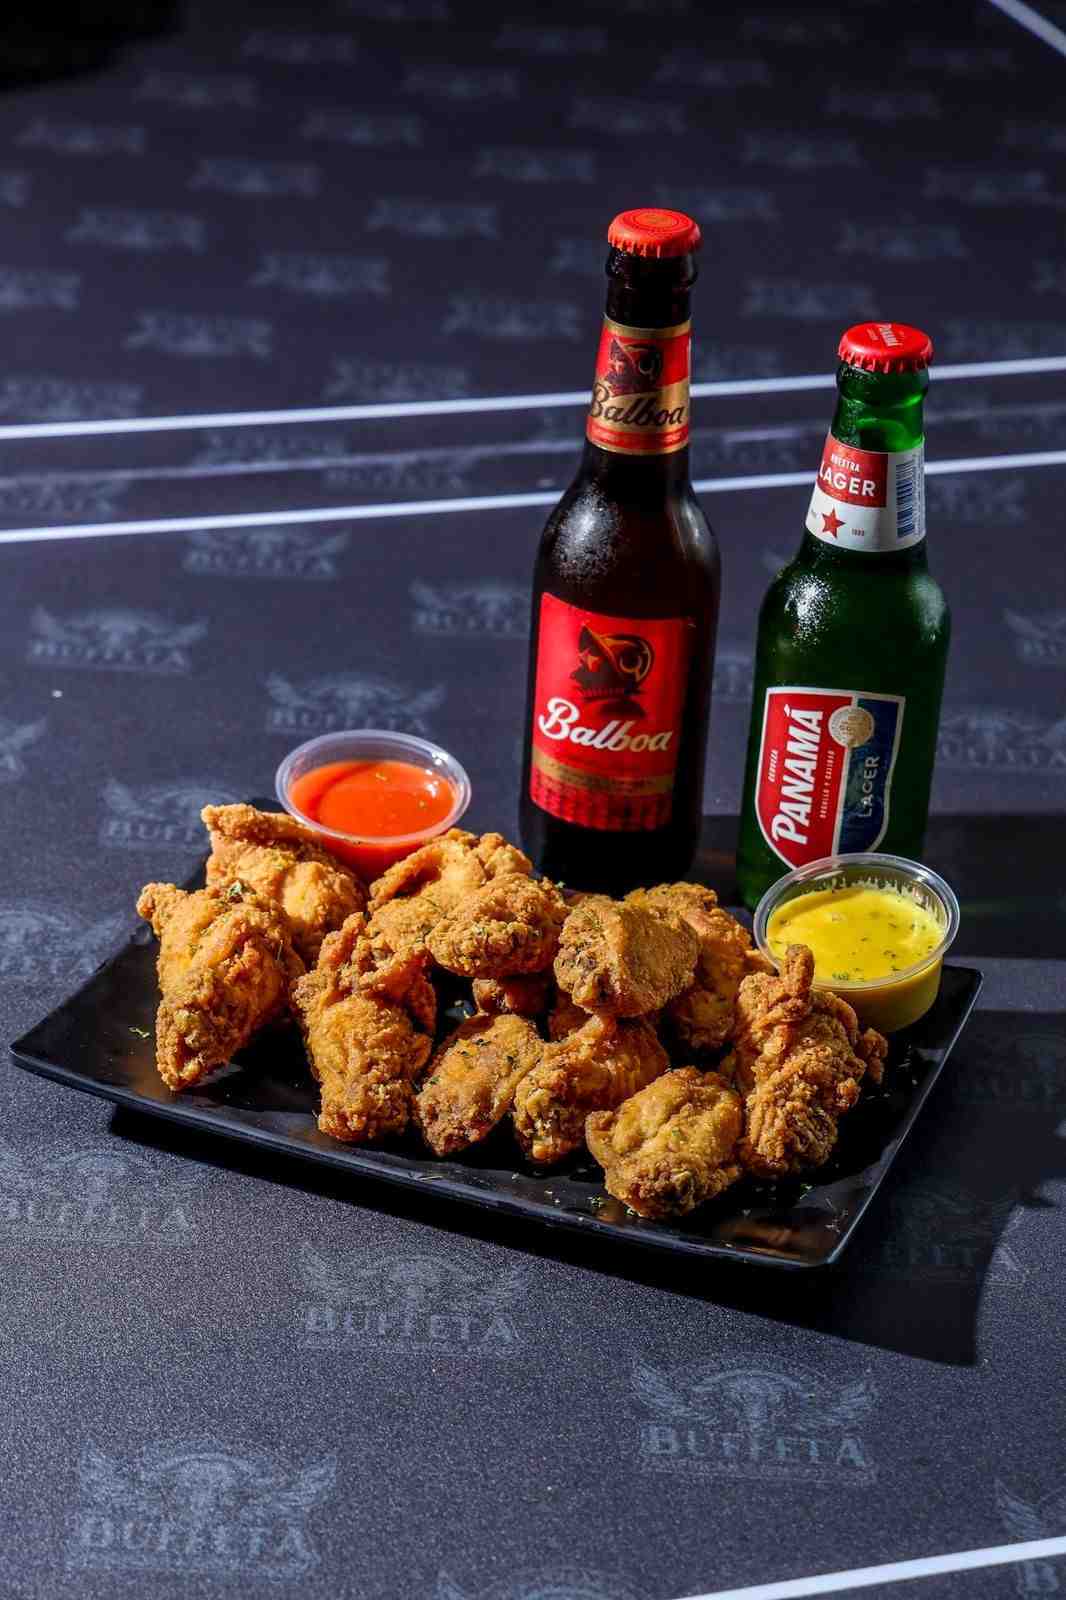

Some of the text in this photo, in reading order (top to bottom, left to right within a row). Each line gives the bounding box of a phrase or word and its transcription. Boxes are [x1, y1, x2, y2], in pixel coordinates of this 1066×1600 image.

[591, 382, 685, 425] Balboa
[820, 459, 876, 497] LAGER
[538, 696, 673, 752] Balboa
[771, 704, 823, 844] PANAMÁ
[861, 755, 880, 818] LAGER
